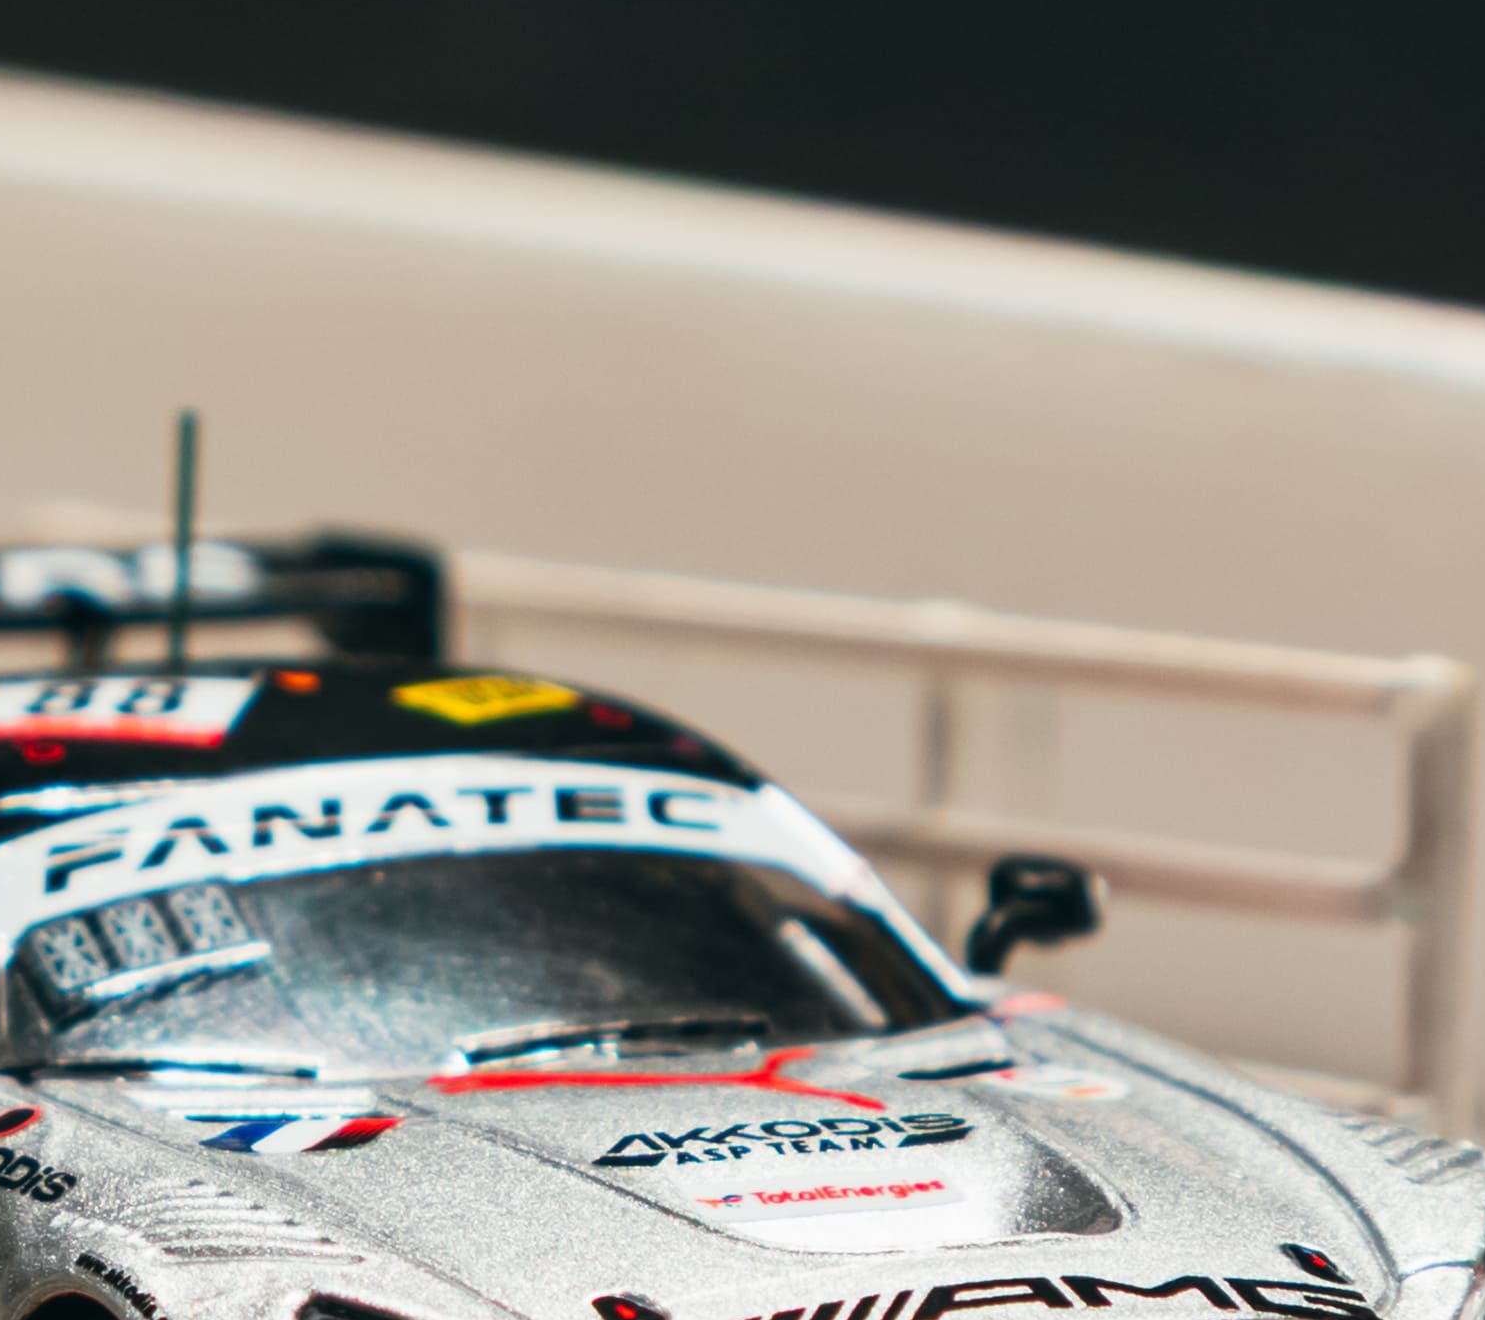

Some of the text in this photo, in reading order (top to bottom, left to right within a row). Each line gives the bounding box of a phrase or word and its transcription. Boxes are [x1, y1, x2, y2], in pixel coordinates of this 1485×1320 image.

[44, 785, 723, 894] FANATEC
[676, 1137, 887, 1166] ASP TEAM
[749, 1179, 946, 1206] TotalEnergies
